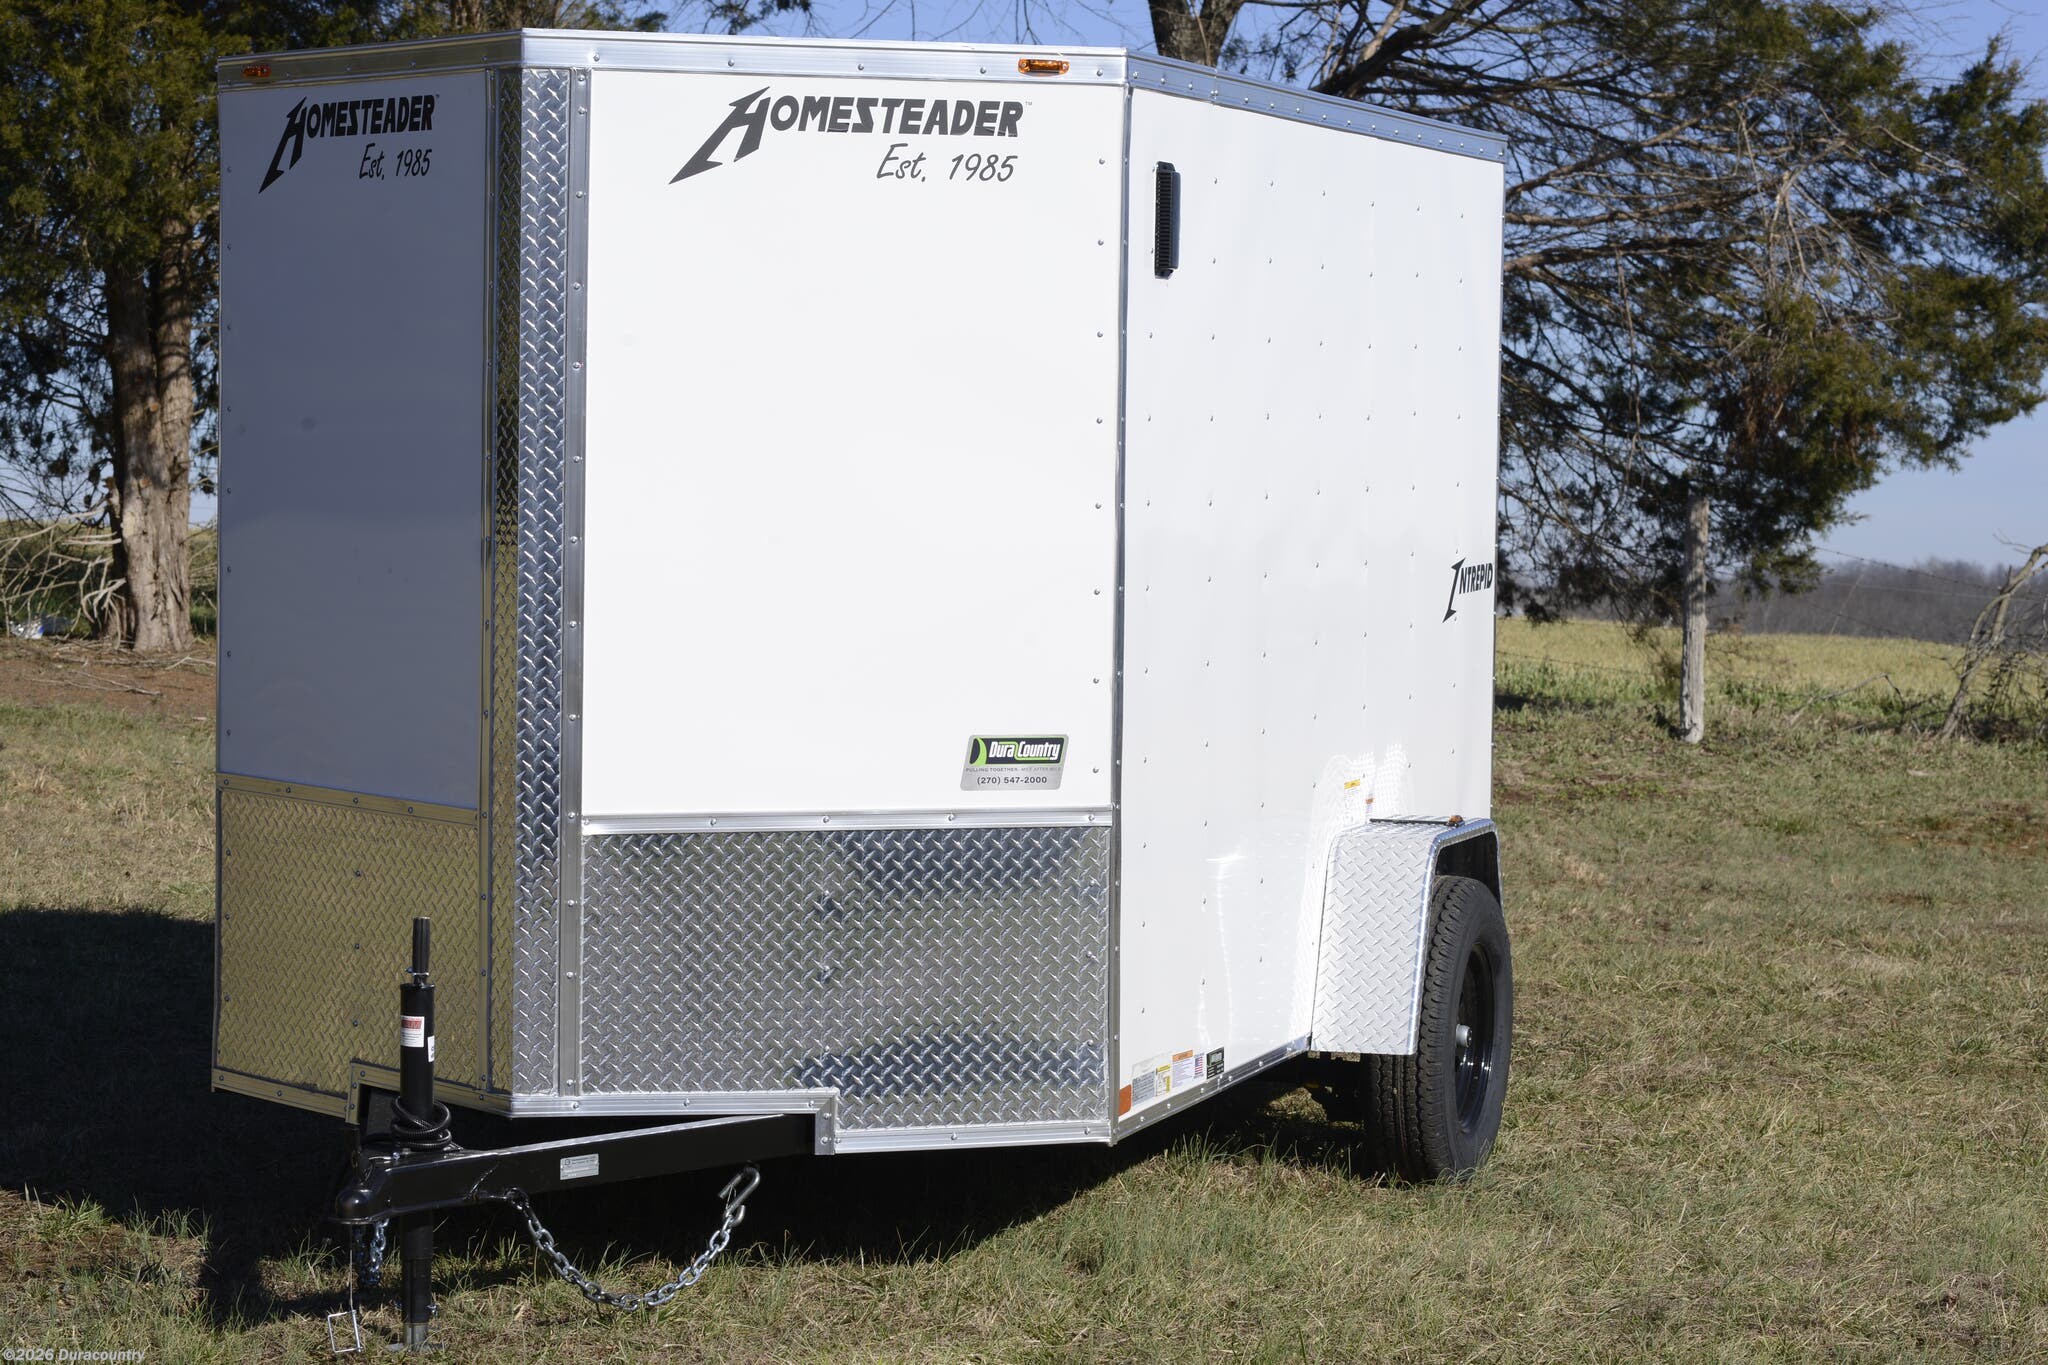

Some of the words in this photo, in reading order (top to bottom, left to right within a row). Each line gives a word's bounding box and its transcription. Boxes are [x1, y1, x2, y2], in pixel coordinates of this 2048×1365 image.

[259, 95, 435, 194] HOMESTEADER
[668, 86, 1024, 185] HOMESTEADER
[396, 149, 433, 177] 1985
[949, 153, 1018, 182] 1985
[1442, 556, 1493, 623] INTREPID
[988, 741, 1015, 758] Dura
[1017, 741, 1060, 761] Country
[977, 776, 1001, 785] (270)
[1003, 776, 1048, 785] 547-2000
